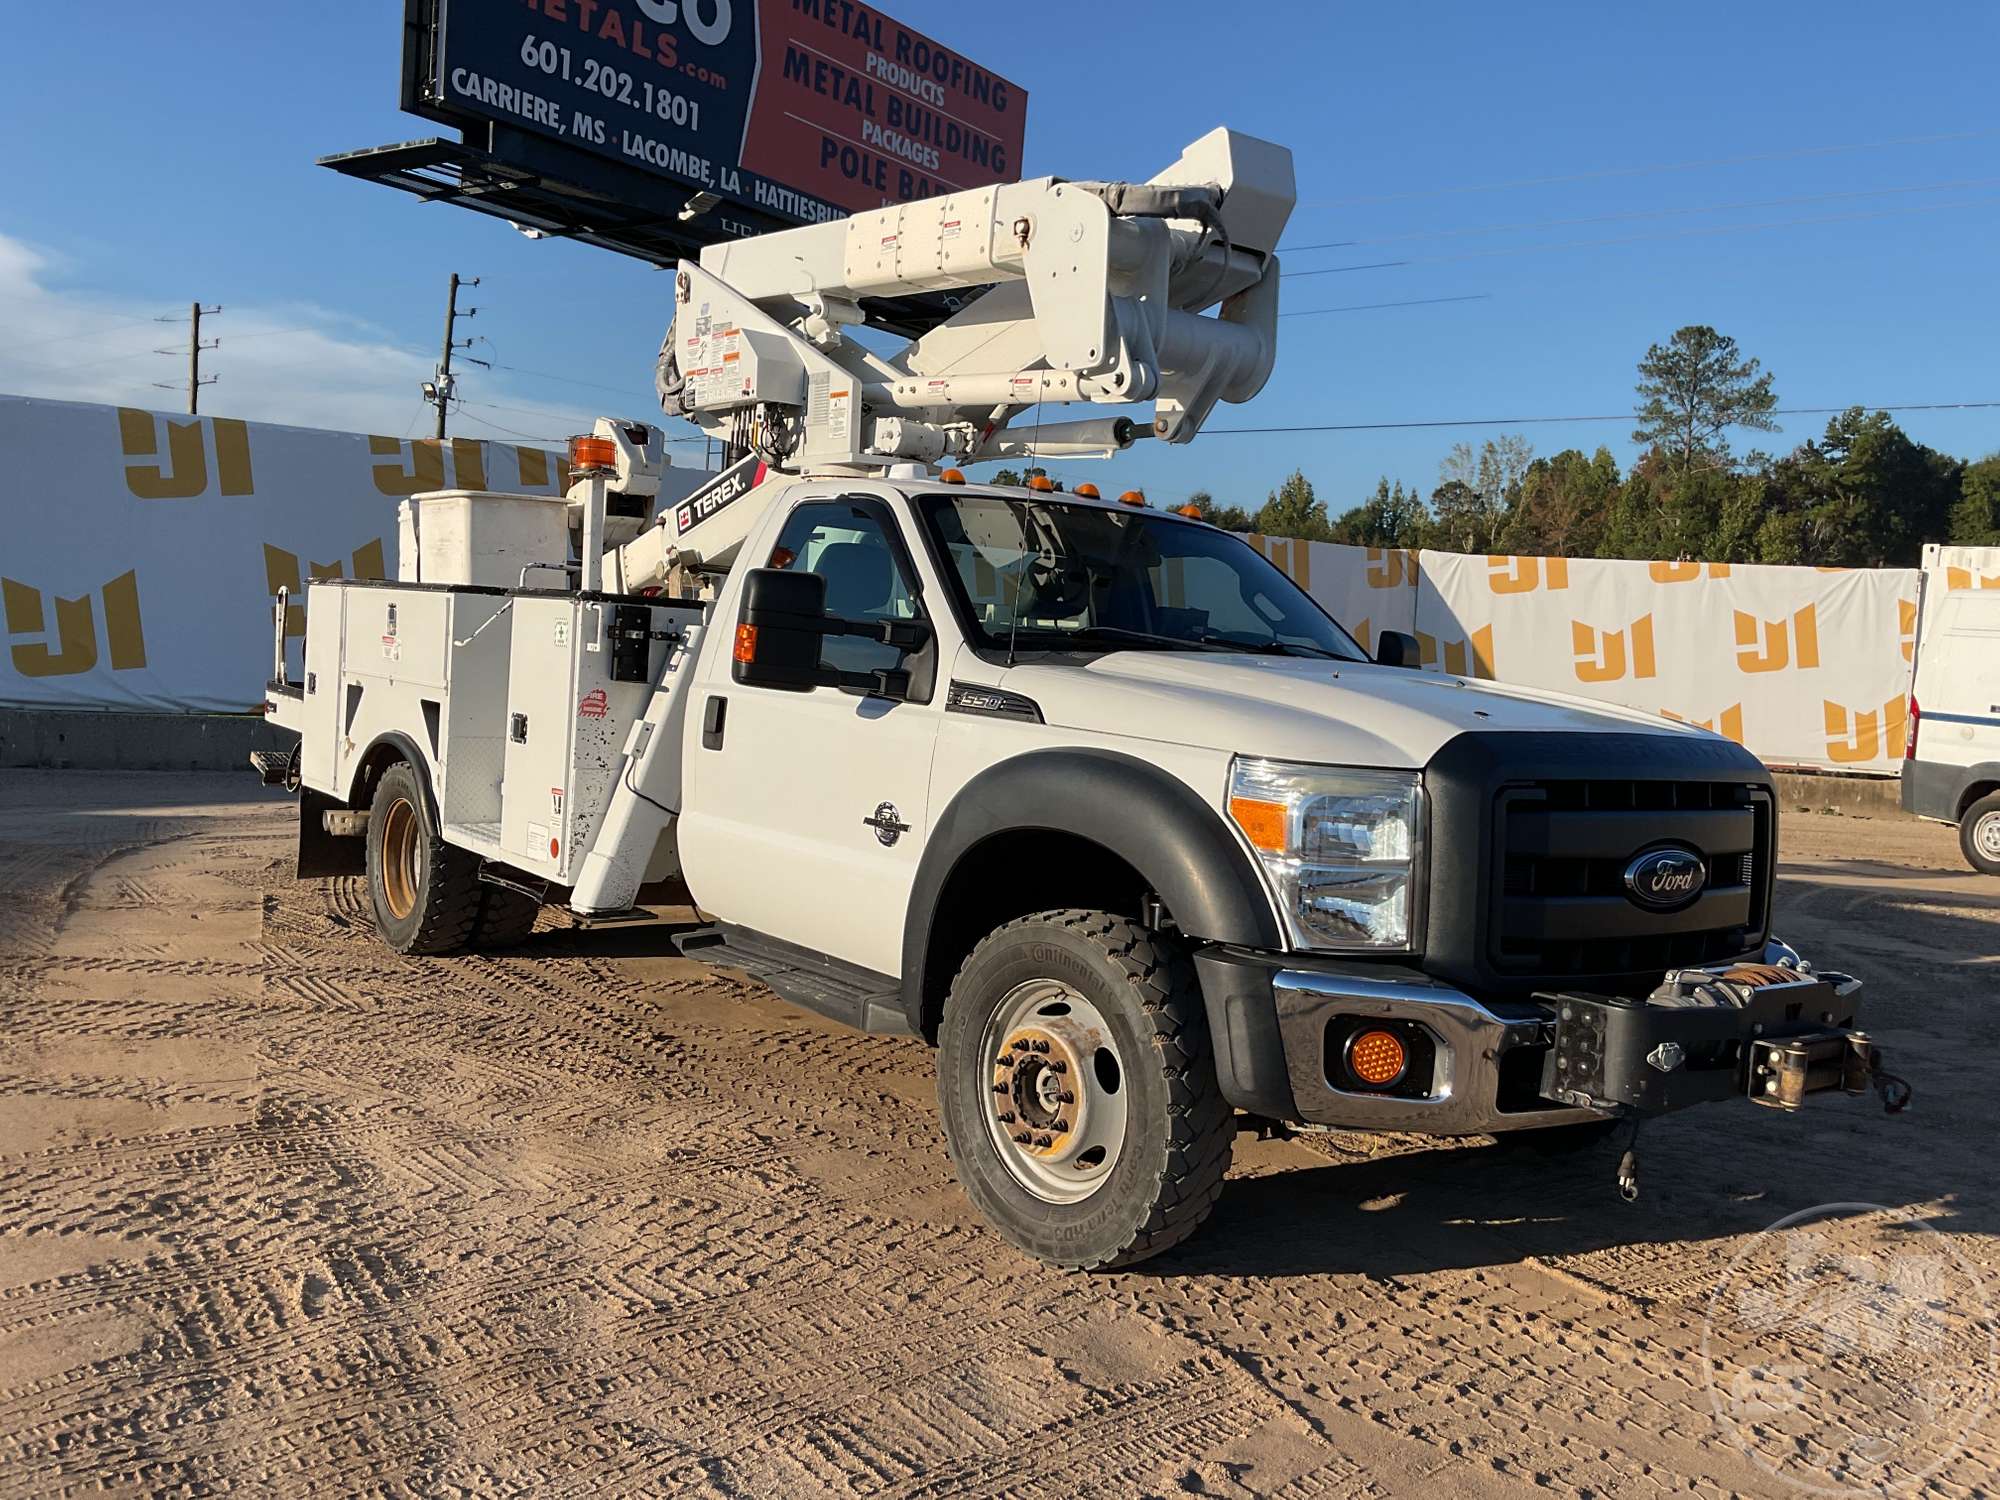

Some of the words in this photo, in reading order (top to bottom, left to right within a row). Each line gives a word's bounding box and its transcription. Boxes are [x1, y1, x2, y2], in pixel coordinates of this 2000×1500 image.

[527, 0, 727, 90] ETALS.com
[866, 52, 945, 107] PRODUCTS
[895, 30, 1008, 113] ROOFING
[520, 34, 699, 131] 601.202.1801
[783, 46, 876, 117] METAL
[886, 94, 1006, 174] BUILDING
[451, 67, 567, 135] CARRIERE,
[572, 111, 606, 144] MS
[622, 130, 716, 188] LACOMBE,
[720, 166, 741, 195] LA
[820, 136, 888, 192] POLE
[862, 119, 940, 171] PACKAGES
[693, 472, 742, 518] TEREX
[1651, 859, 1695, 892] Ford
